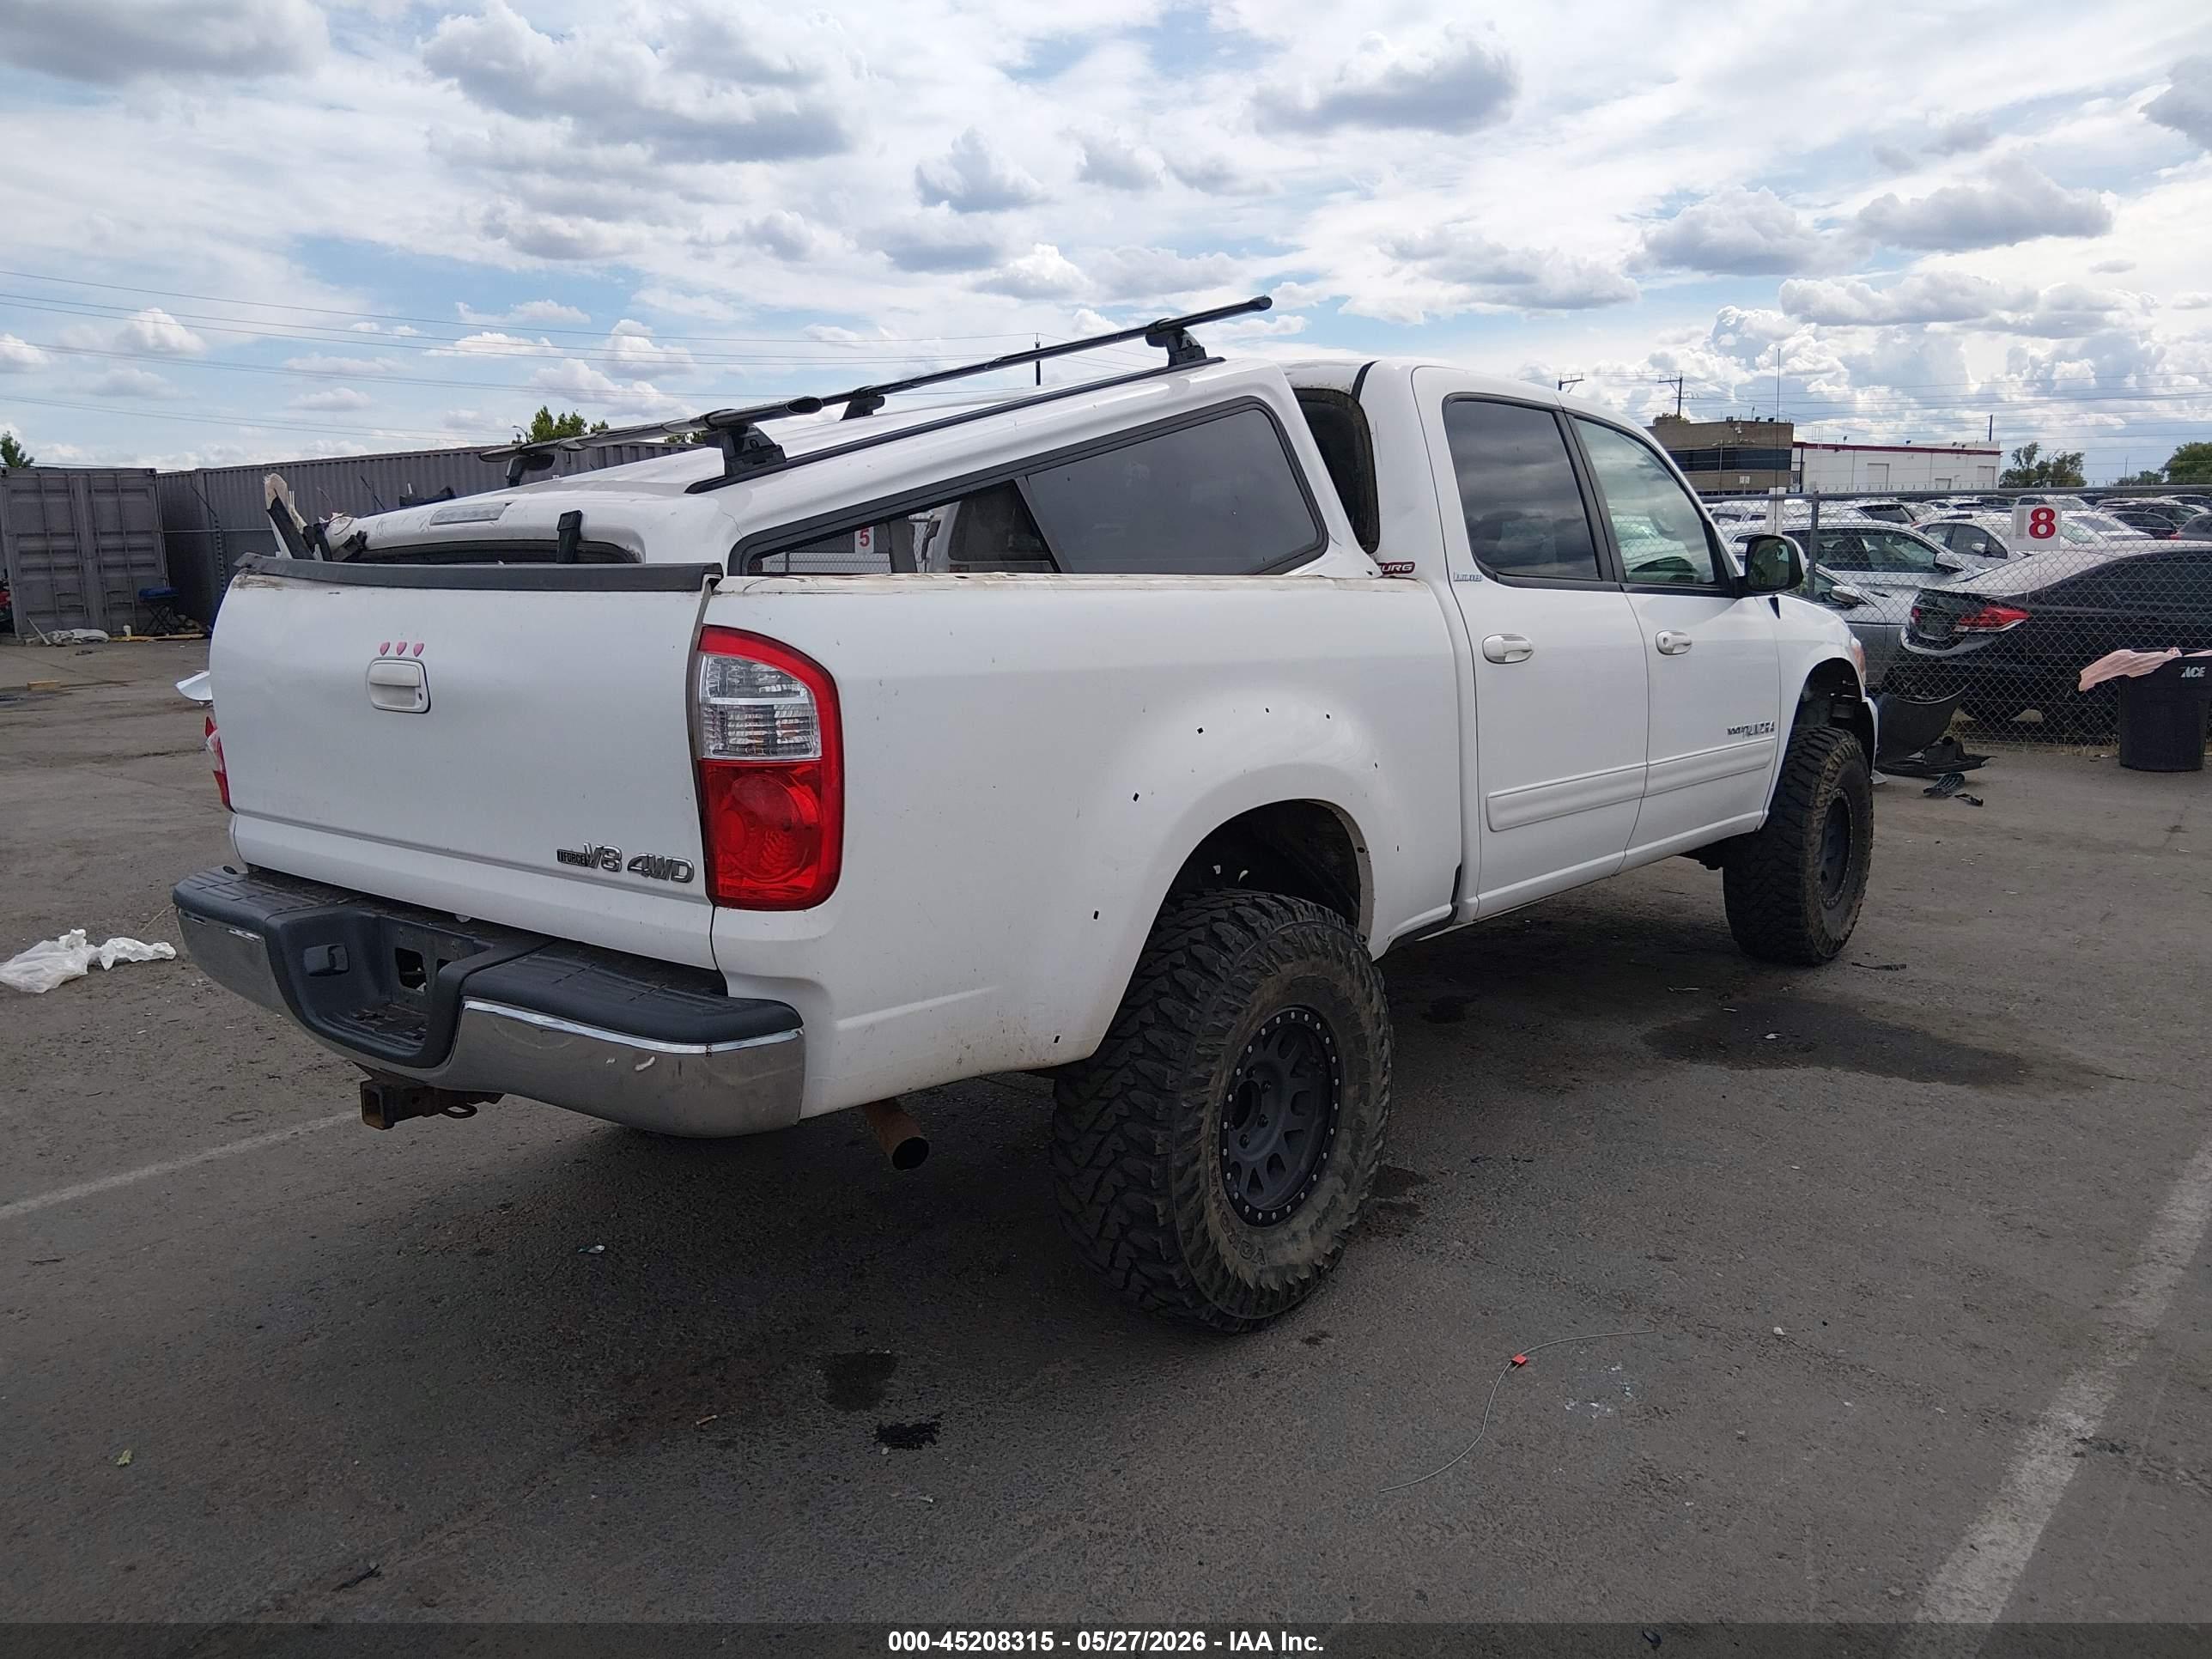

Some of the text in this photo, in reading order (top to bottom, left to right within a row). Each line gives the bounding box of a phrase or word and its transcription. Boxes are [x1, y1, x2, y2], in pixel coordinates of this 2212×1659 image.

[2028, 507, 2056, 539] 8
[860, 527, 870, 547] 5
[1378, 563, 1413, 572] URG
[2180, 665, 2206, 678] ACE
[584, 842, 623, 872] V8
[627, 852, 695, 884] 4WD
